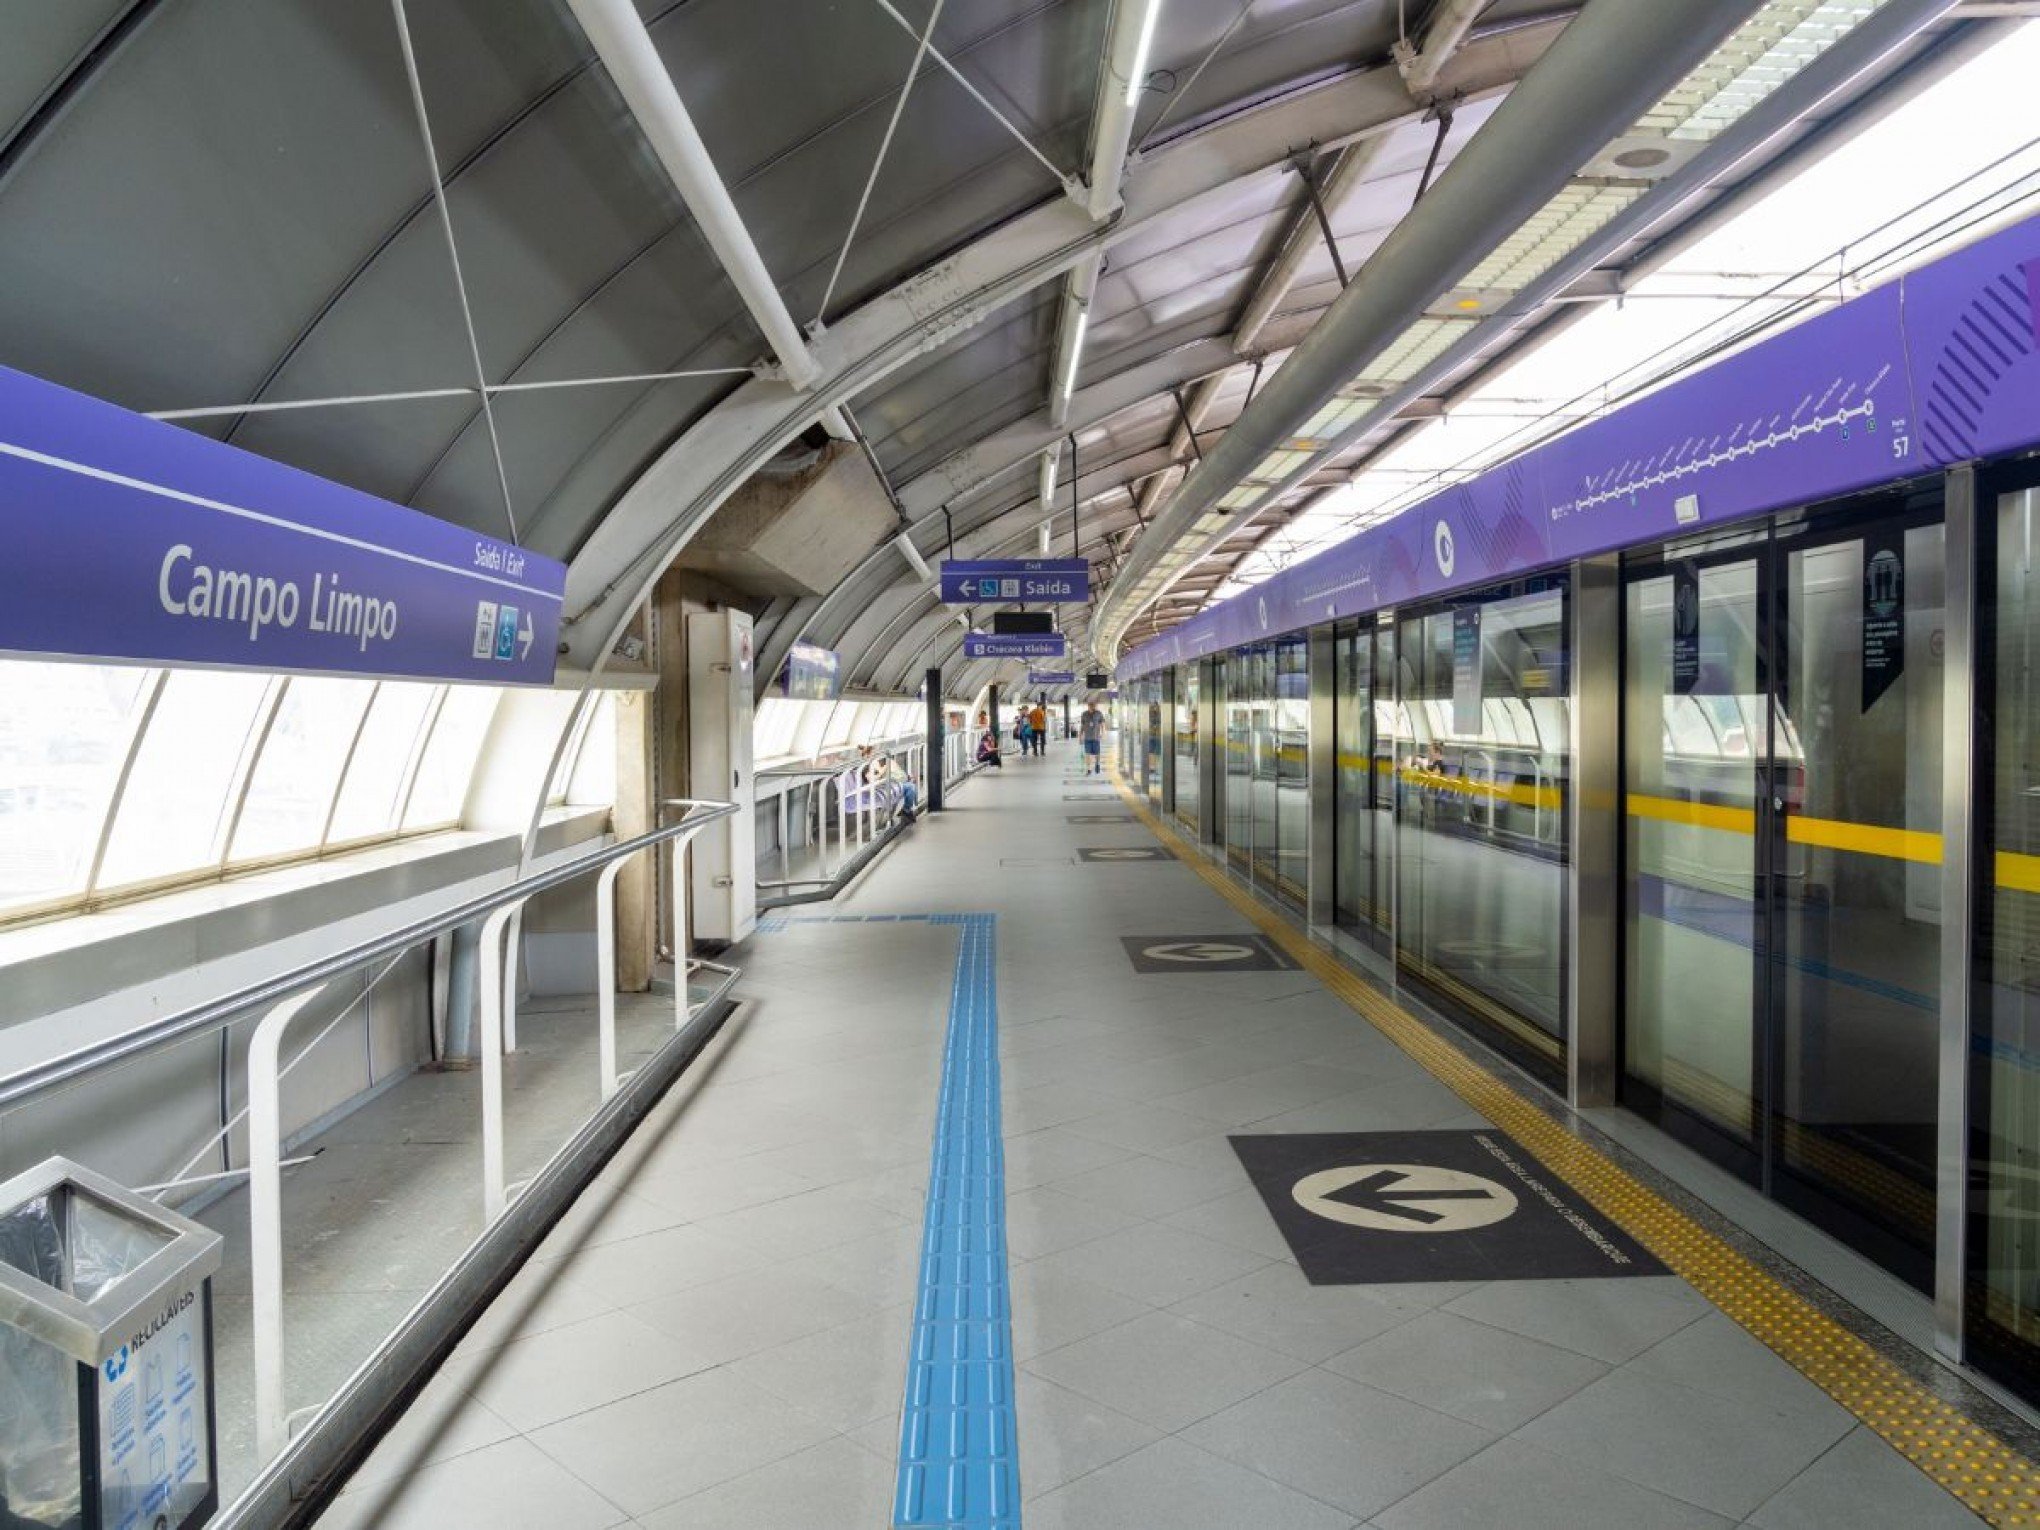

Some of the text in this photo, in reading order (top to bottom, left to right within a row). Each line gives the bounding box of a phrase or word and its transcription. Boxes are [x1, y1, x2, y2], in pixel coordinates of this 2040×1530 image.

[1893, 437, 1908, 457] 57
[1025, 562, 1041, 570] Exit
[159, 544, 397, 651] Campo Limpo
